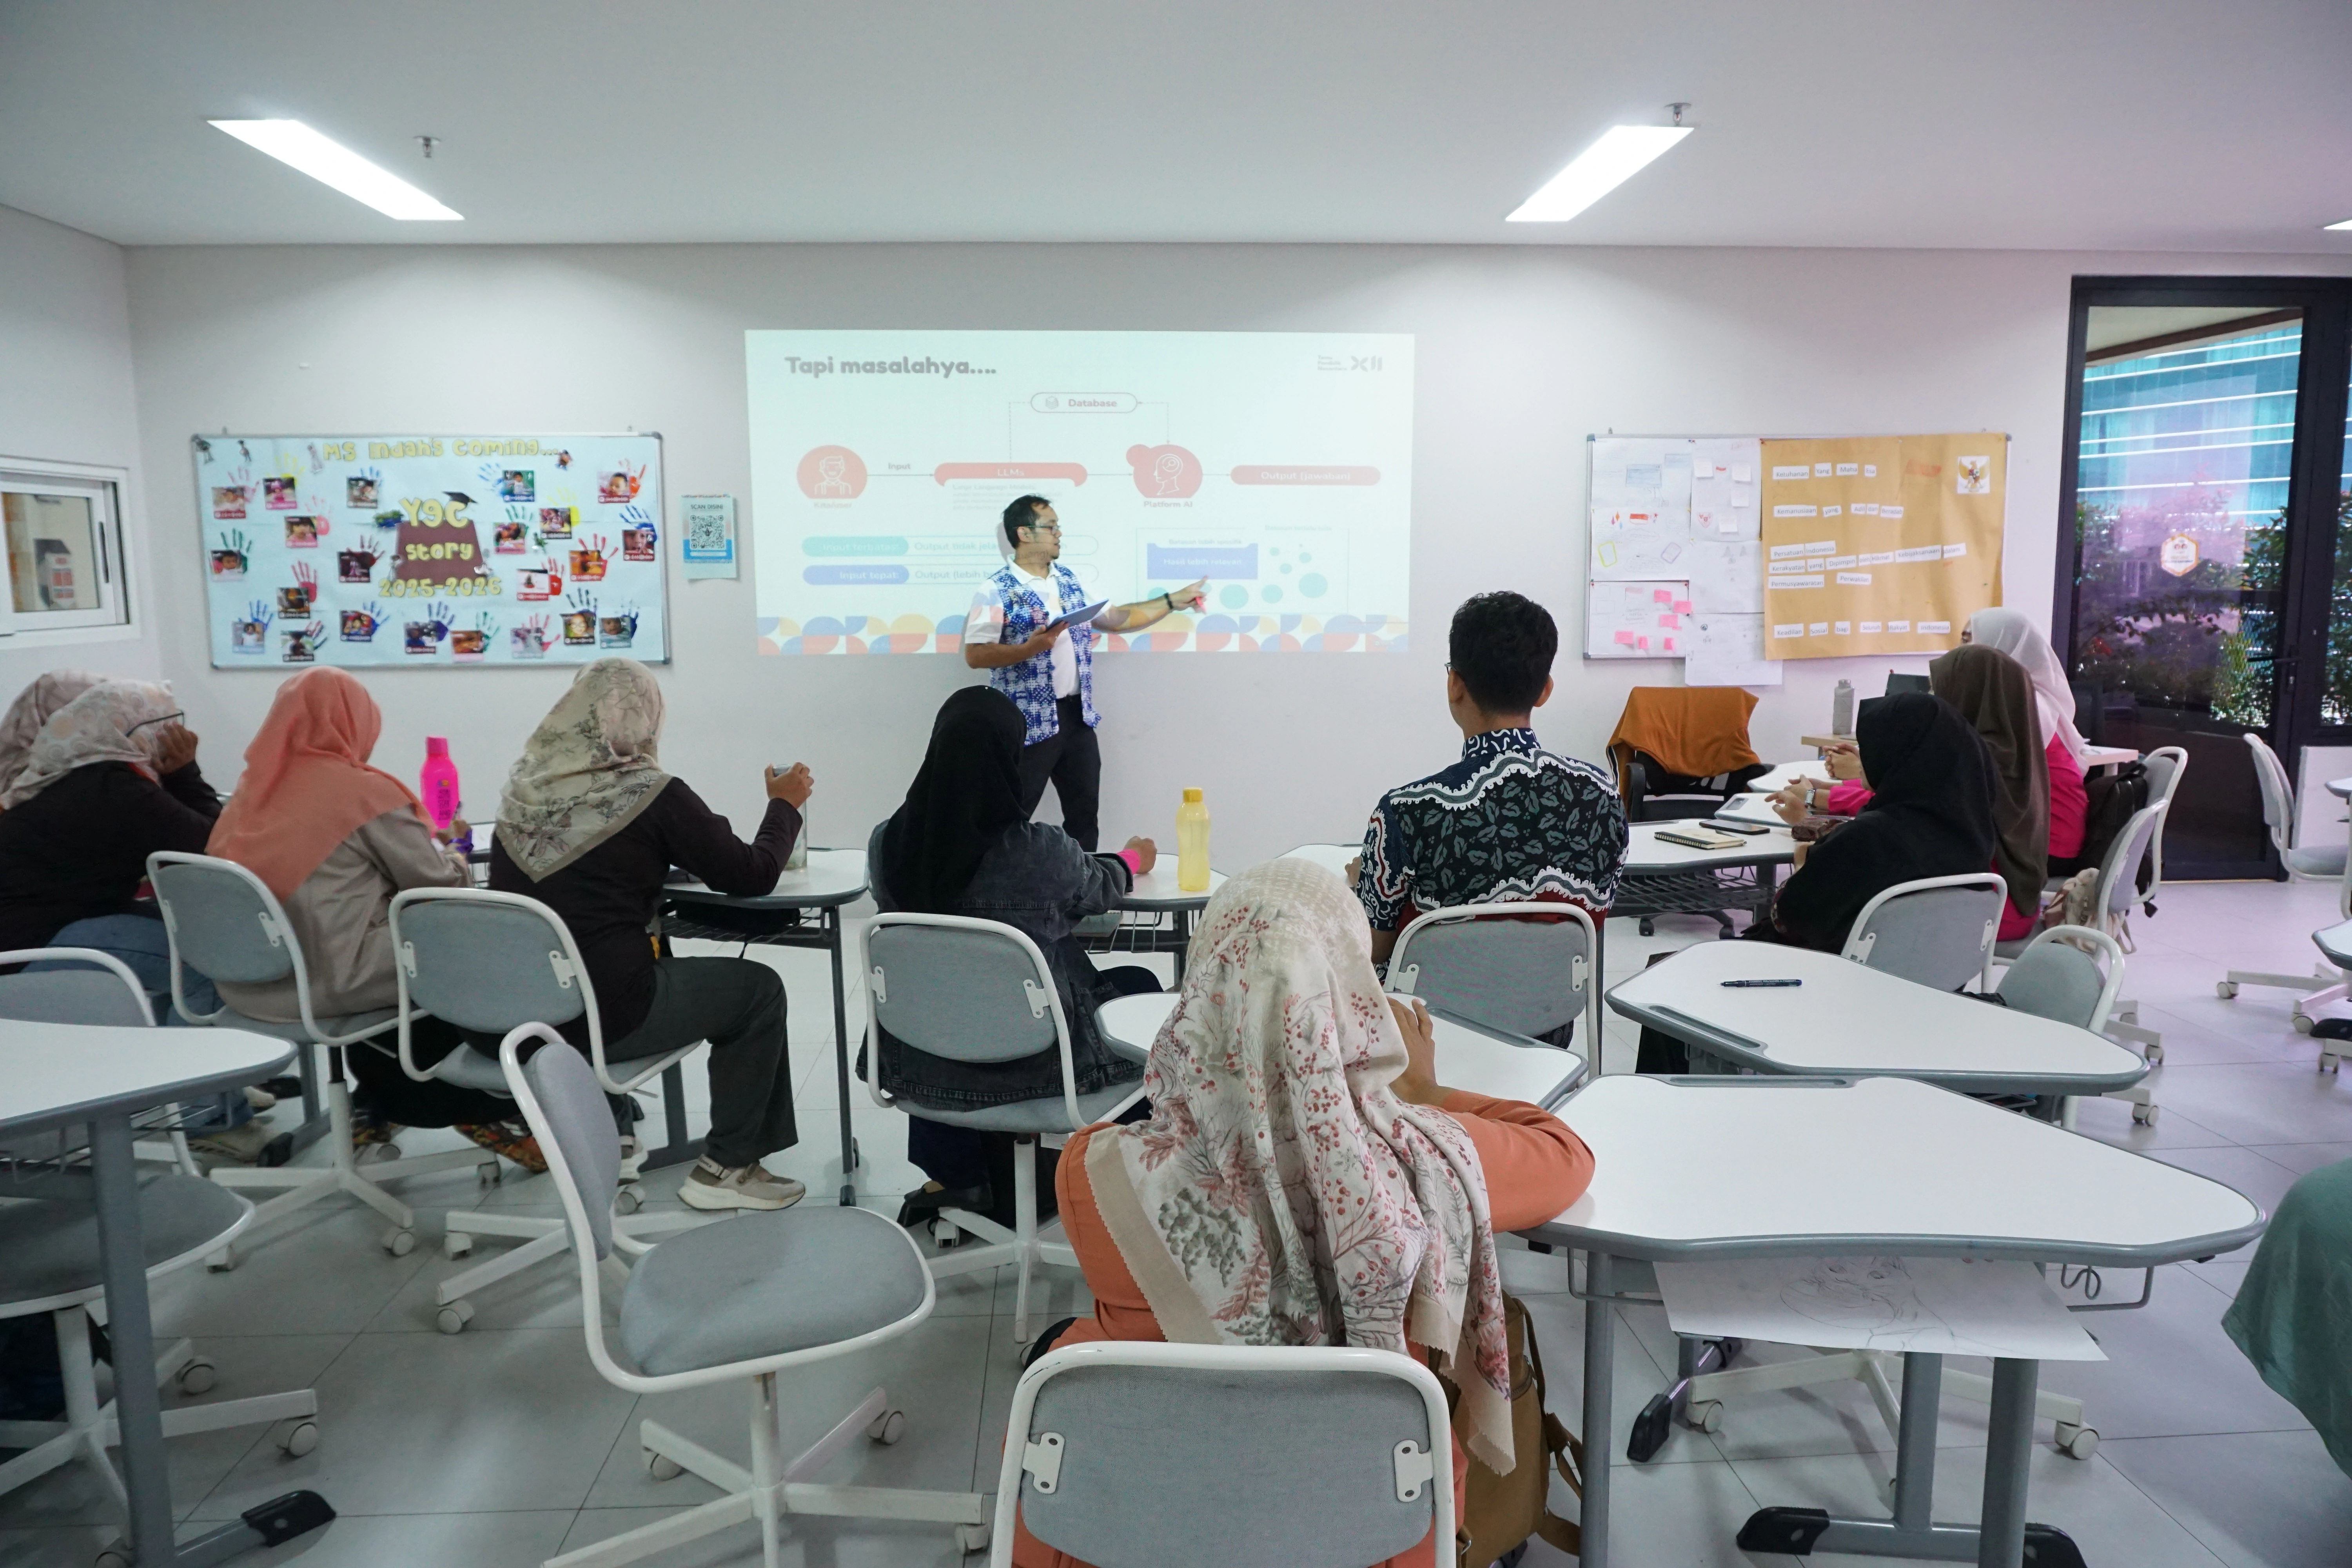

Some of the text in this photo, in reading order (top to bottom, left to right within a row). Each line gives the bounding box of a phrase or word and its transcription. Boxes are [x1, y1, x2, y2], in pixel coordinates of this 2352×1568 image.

[785, 356, 996, 378] Tapi masalahya....
[1068, 399, 1117, 407] Database
[1261, 471, 1297, 480] Output
[399, 497, 469, 528] Y9C
[405, 542, 473, 561] story
[979, 542, 997, 551] jela
[1829, 559, 1855, 567] Dipimpin
[1898, 549, 1940, 558] Kebijaksanaan
[840, 572, 866, 580] Input
[915, 570, 949, 579] Output
[953, 571, 980, 579] (lebih
[378, 577, 501, 597] 2025-2026
